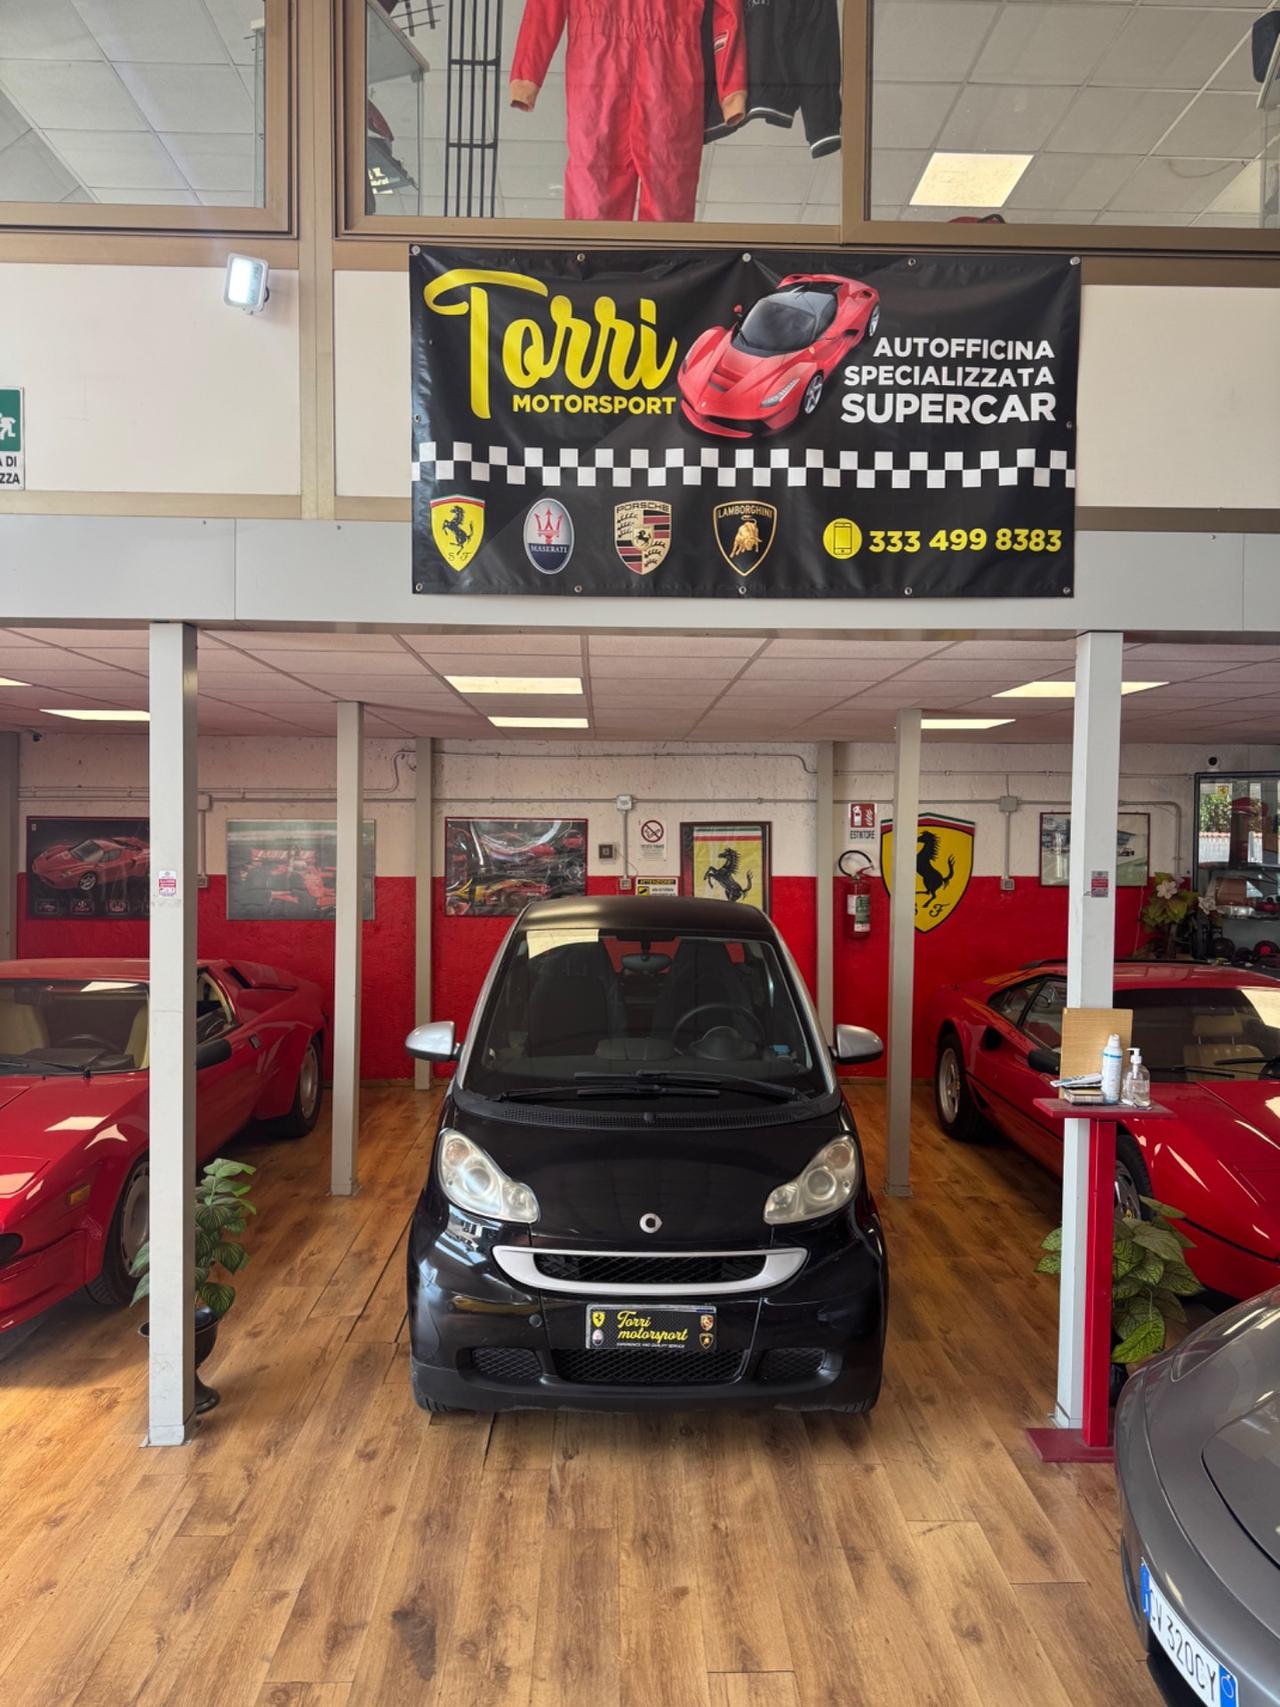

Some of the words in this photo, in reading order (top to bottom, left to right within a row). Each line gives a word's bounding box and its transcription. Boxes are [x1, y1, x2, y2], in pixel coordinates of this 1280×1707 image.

[424, 268, 678, 419] Torri
[873, 337, 1055, 360] AUTOFFICINA
[843, 365, 1055, 388] SPECIALIZZATA
[513, 394, 676, 414] MOTORSPORT
[840, 392, 1056, 424] SUPERCAR
[6, 456, 17, 467] DI
[616, 501, 670, 513] PORSCHE
[718, 504, 772, 518] LAMBORGHINI
[530, 544, 568, 553] MASERATI
[869, 530, 921, 552] 333
[929, 528, 987, 551] 499
[995, 528, 1062, 552] 8383
[616, 1310, 651, 1328] Torri
[617, 1327, 688, 1344] motorsport
